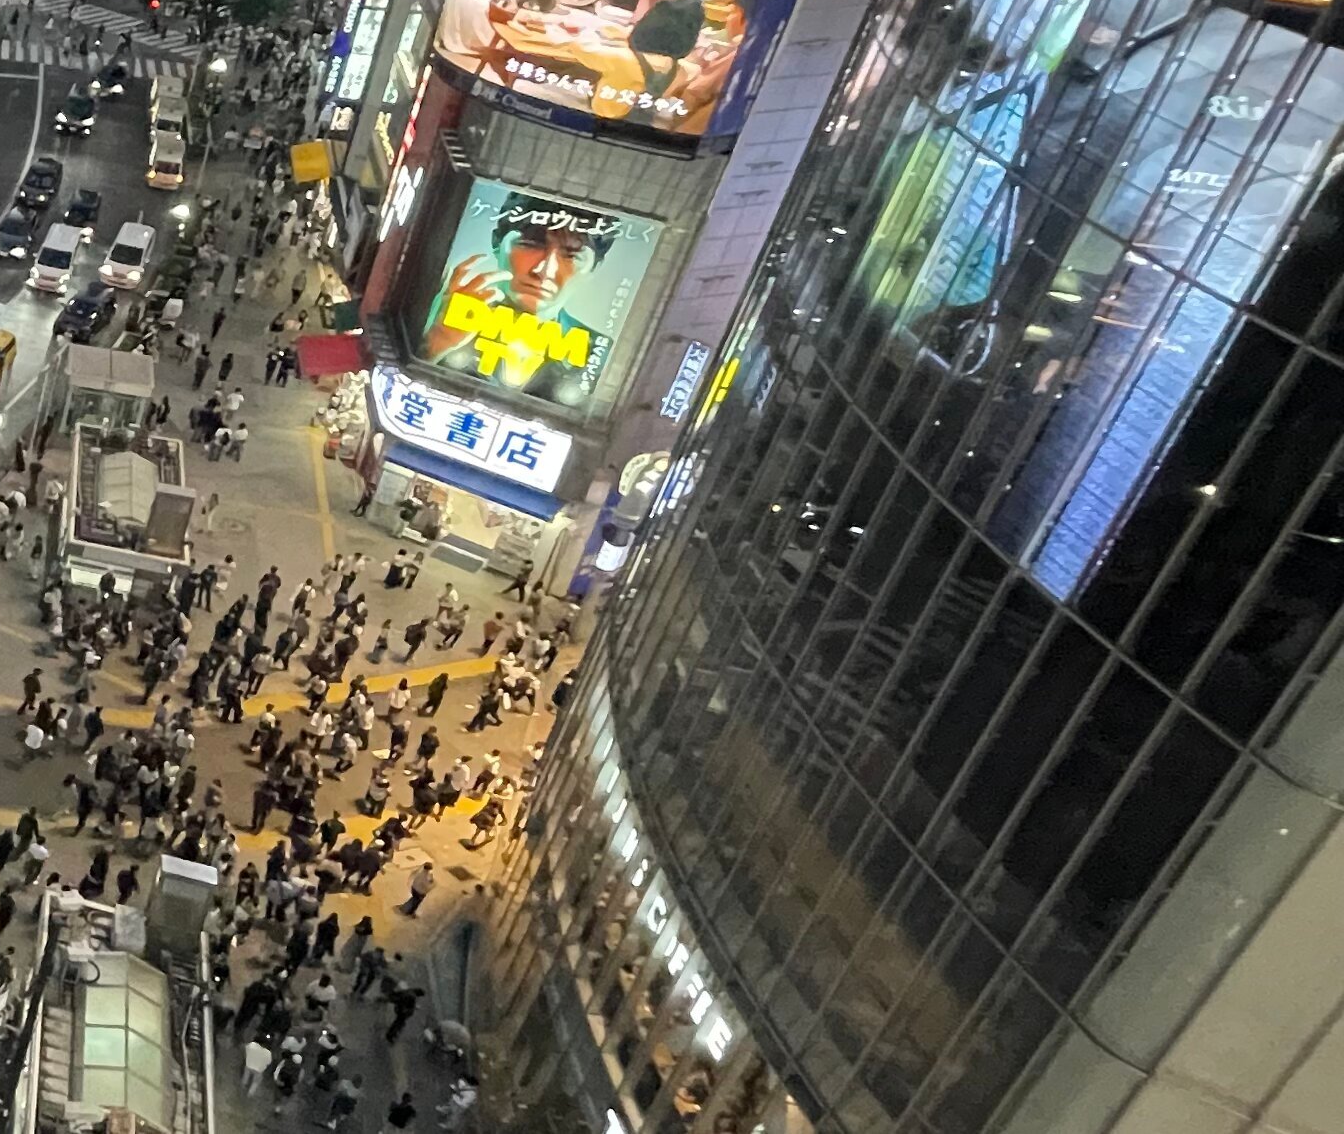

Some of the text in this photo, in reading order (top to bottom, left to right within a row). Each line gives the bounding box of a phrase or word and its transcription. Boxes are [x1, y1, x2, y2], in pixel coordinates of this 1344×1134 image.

[470, 197, 656, 244] ケンシロウによろしく
[443, 291, 590, 369] DMM
[474, 337, 546, 388] TV
[382, 374, 547, 471] 堂書店
